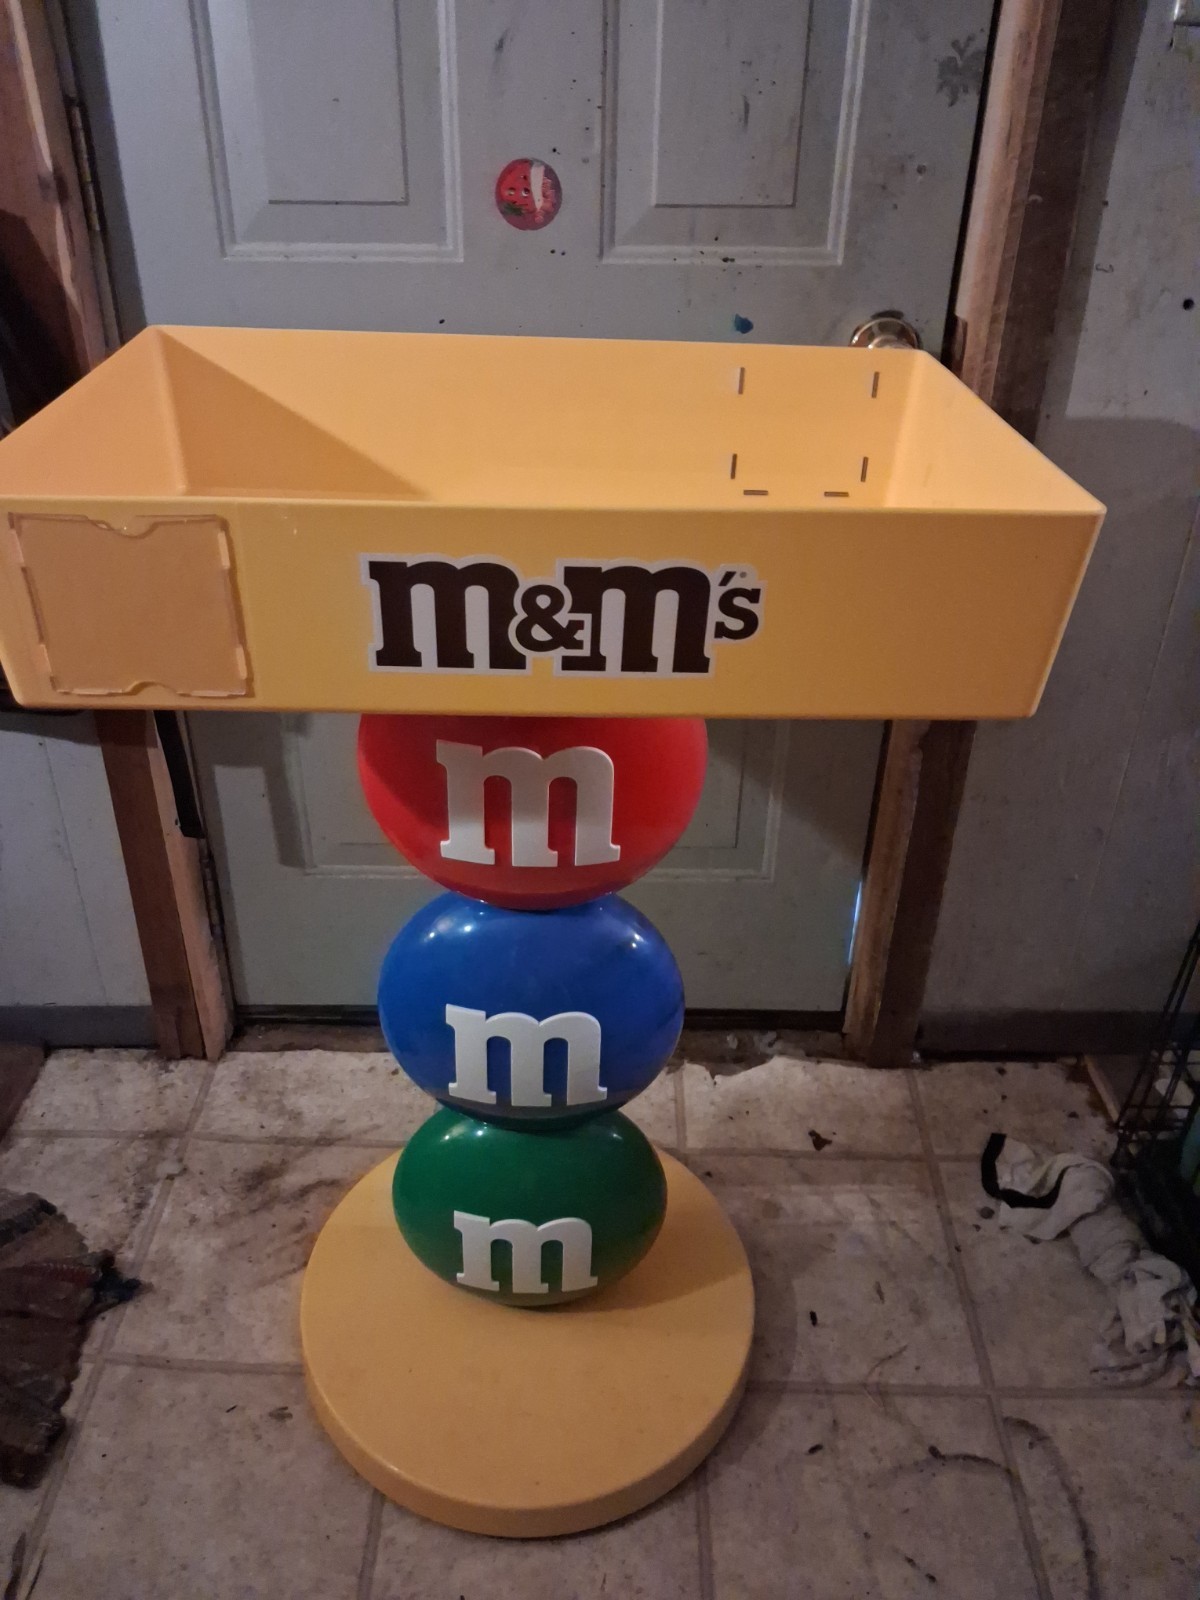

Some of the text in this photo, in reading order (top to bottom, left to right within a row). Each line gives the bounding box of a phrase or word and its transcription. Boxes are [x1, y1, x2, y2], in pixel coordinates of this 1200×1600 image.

[436, 739, 621, 867] m
[445, 1003, 608, 1107] m
[453, 1210, 598, 1294] m
